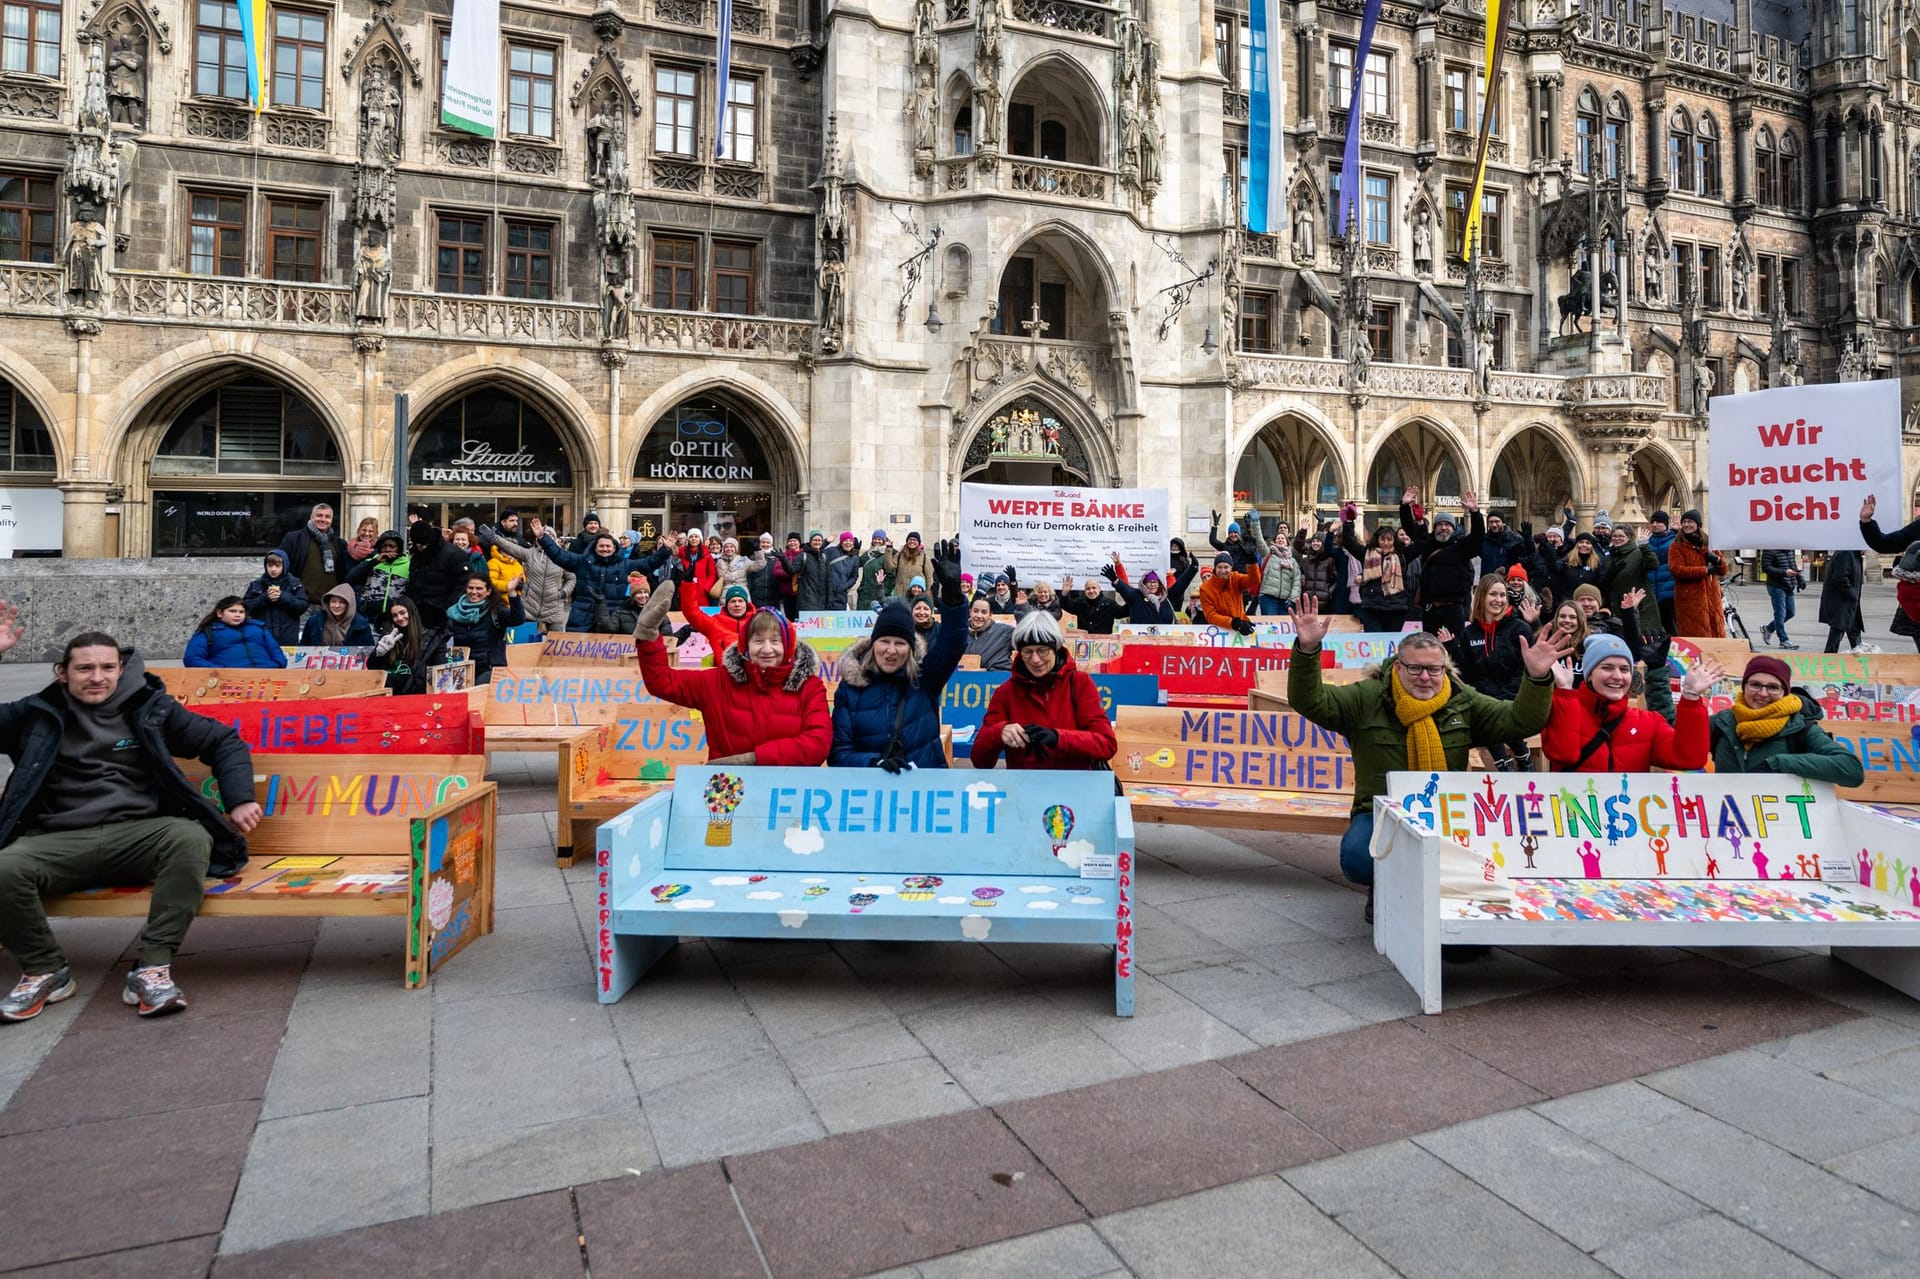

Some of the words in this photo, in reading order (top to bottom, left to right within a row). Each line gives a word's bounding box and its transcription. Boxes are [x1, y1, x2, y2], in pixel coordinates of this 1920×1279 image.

[1757, 419, 1823, 448] Wir
[451, 440, 535, 466] Linda
[670, 441, 734, 458] OPTIK
[422, 468, 557, 484] HAARSCHMUCK
[650, 463, 753, 479] HÖRTKORN
[1729, 457, 1867, 486] braucht
[988, 499, 1065, 517] WERTE
[1071, 498, 1145, 519] BÄNKE
[1749, 495, 1840, 522] Dich!
[973, 519, 1023, 530] München
[1025, 521, 1040, 530] für
[1043, 522, 1105, 532] Demokratie
[1118, 524, 1159, 532] Freiheit
[495, 678, 665, 704] GEMEINSC
[1185, 748, 1353, 790] FREIHEI
[767, 787, 1007, 835] FREIHEIT
[1401, 792, 1816, 840] GEMEINSCHAFT
[597, 850, 613, 992] RESPEKT
